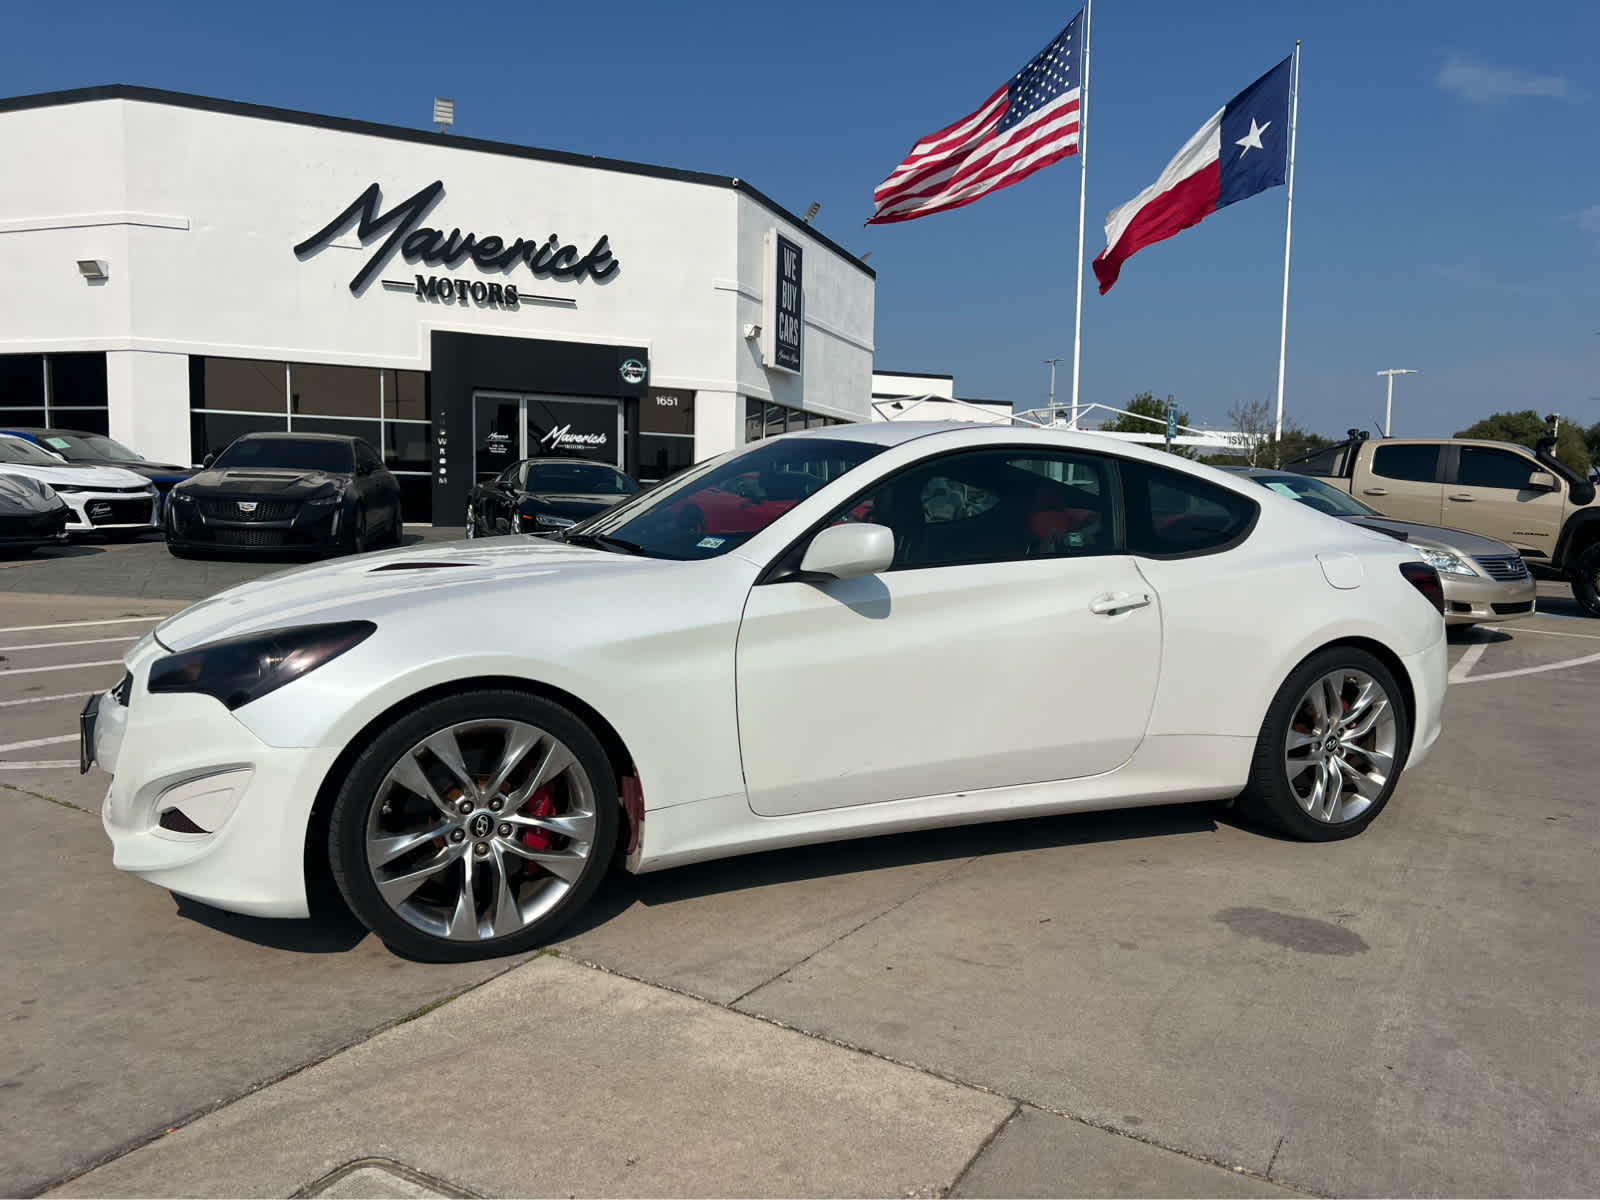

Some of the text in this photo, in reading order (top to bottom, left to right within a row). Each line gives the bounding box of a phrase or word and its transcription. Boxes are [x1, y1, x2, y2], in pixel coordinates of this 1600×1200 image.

[293, 180, 619, 293] Maverick
[783, 247, 797, 281] WE
[415, 274, 519, 306] MOTORS
[782, 279, 797, 313] BUY
[779, 312, 799, 347] CARS
[656, 396, 678, 406] 1651
[541, 424, 607, 450] Maverick
